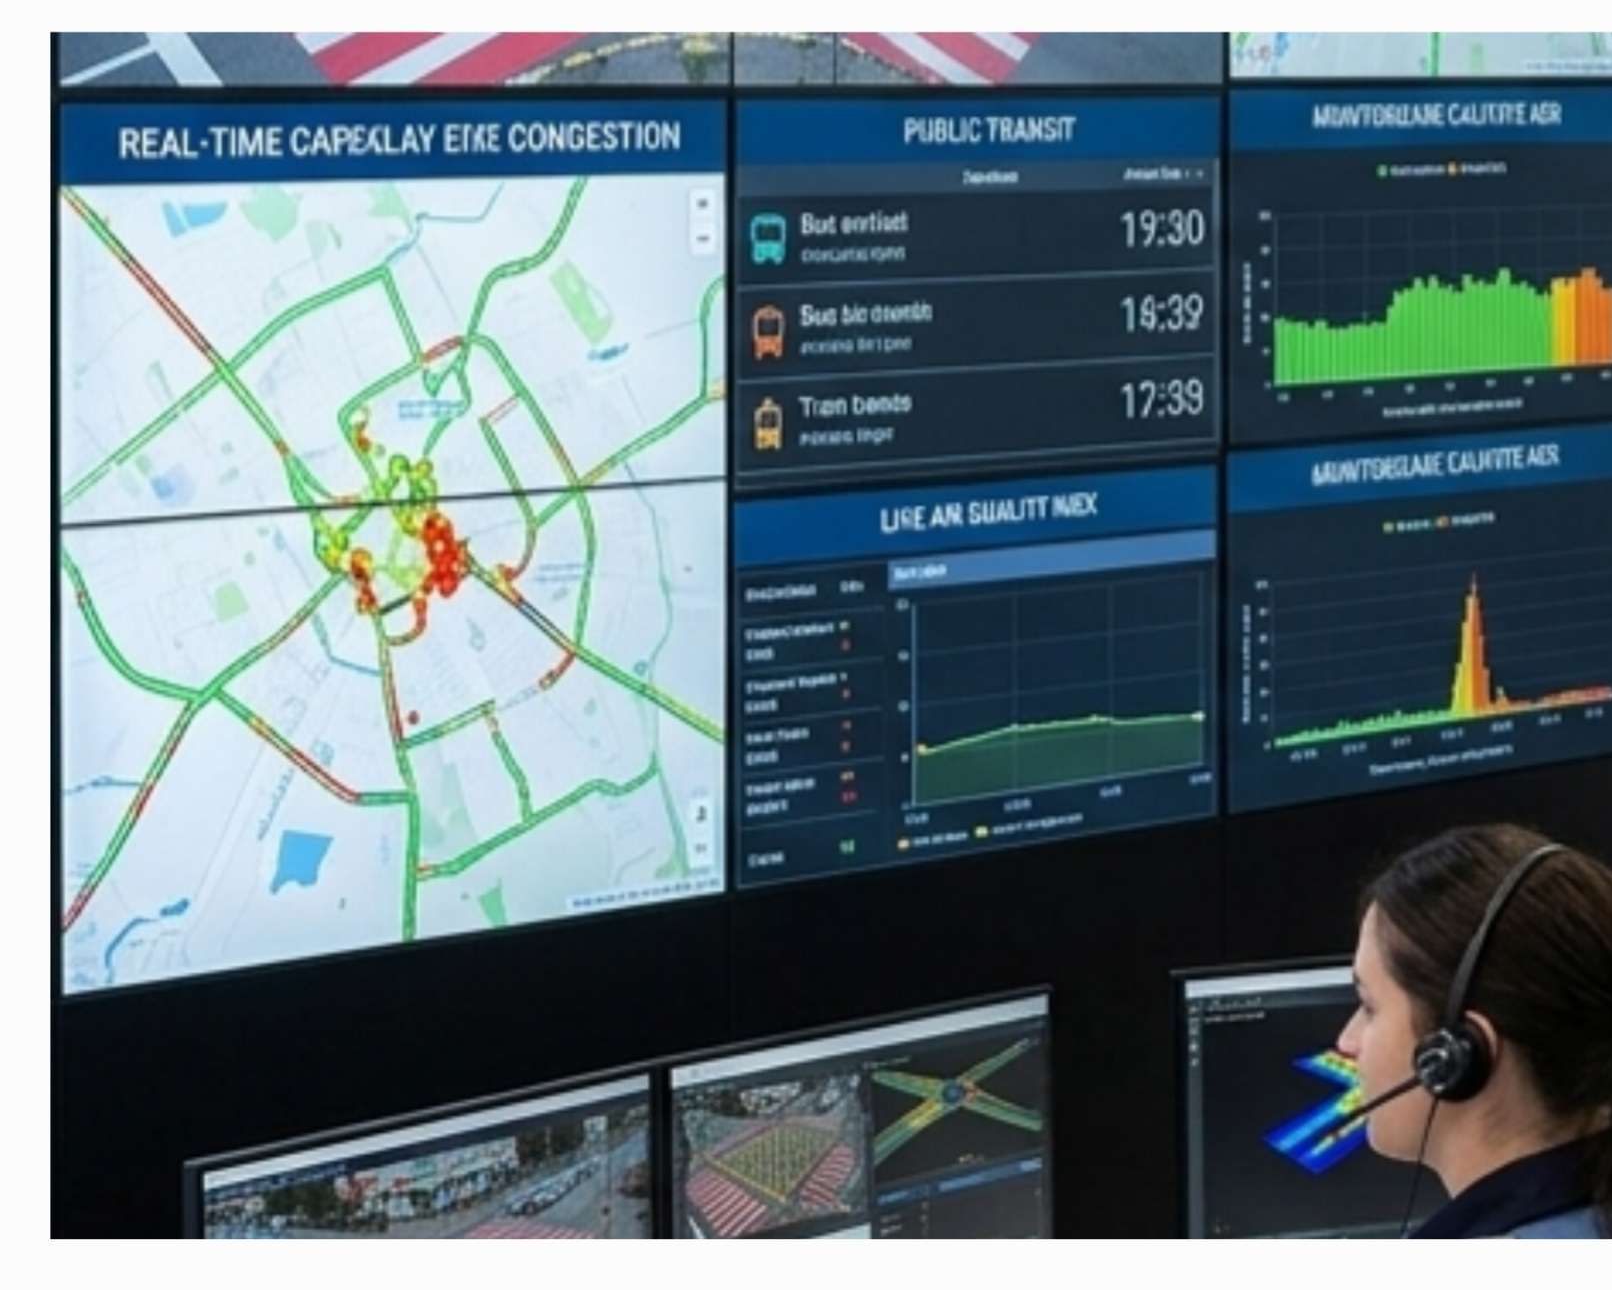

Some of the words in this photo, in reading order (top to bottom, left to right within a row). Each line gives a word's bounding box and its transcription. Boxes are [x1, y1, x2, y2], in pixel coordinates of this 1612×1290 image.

[119, 126, 284, 159] REAL-TIME
[507, 119, 682, 154] CONGESTION
[903, 116, 982, 145] PUBLIC
[986, 115, 1077, 143] TRANSIT
[1120, 208, 1206, 249] 19:30
